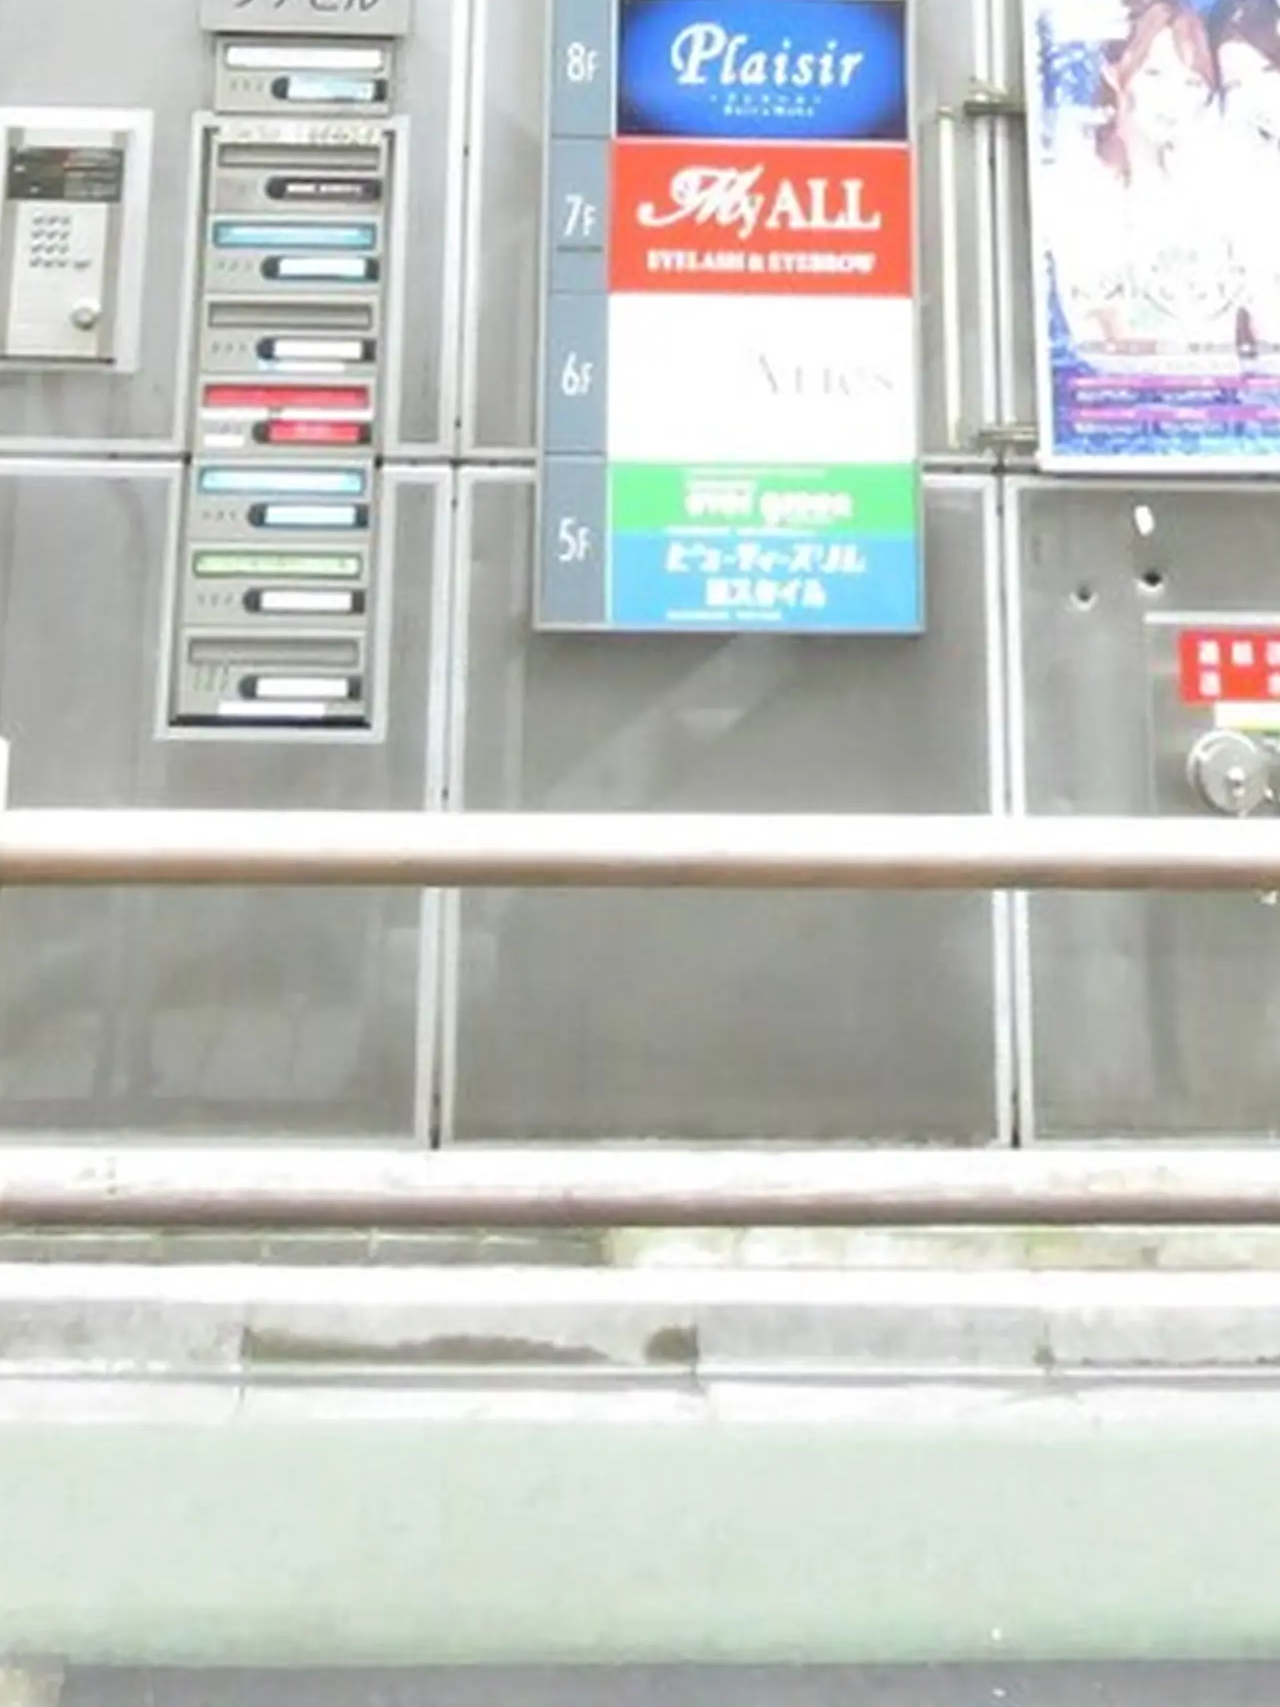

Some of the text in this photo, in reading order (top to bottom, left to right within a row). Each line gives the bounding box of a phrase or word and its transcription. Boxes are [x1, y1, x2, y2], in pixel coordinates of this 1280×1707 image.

[566, 42, 601, 82] 8F
[670, 20, 864, 88] Plaisir
[563, 194, 597, 238] 7F
[765, 179, 883, 232] ALL
[646, 248, 745, 274] EYELASH
[561, 352, 594, 396] 6F
[558, 518, 591, 562] 5F
